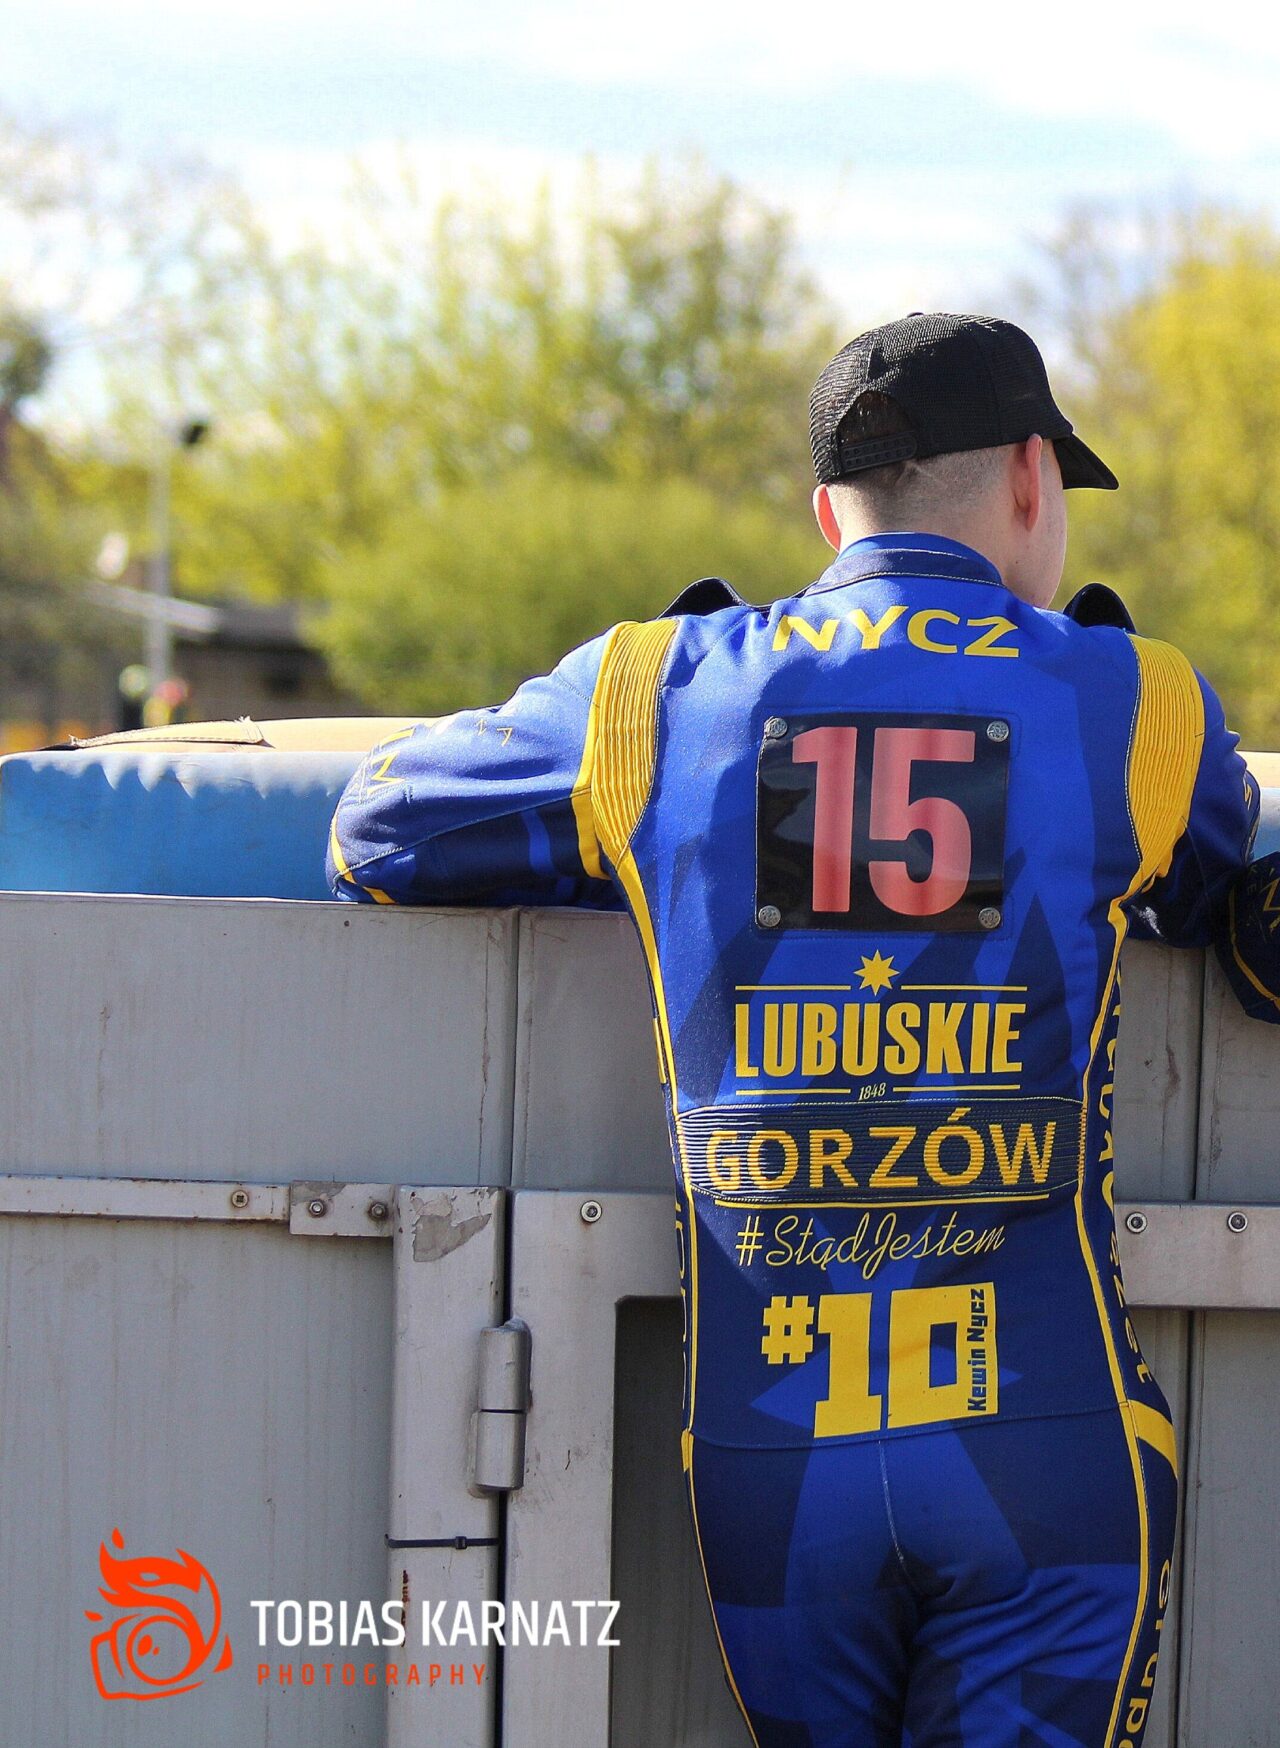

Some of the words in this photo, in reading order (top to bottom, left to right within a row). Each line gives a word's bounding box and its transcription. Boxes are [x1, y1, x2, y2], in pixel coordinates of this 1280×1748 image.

[771, 605, 1020, 658] NYCZ
[791, 726, 976, 916] 15
[734, 1002, 1028, 1078] LUBUSKIE
[858, 1082, 887, 1101] 1848
[705, 1107, 1057, 1192] GORZÓW
[735, 1211, 1006, 1281] #StądJestem
[966, 1288, 988, 1342] Nycz
[760, 1282, 1000, 1438] #10
[967, 1348, 987, 1411] Kewin
